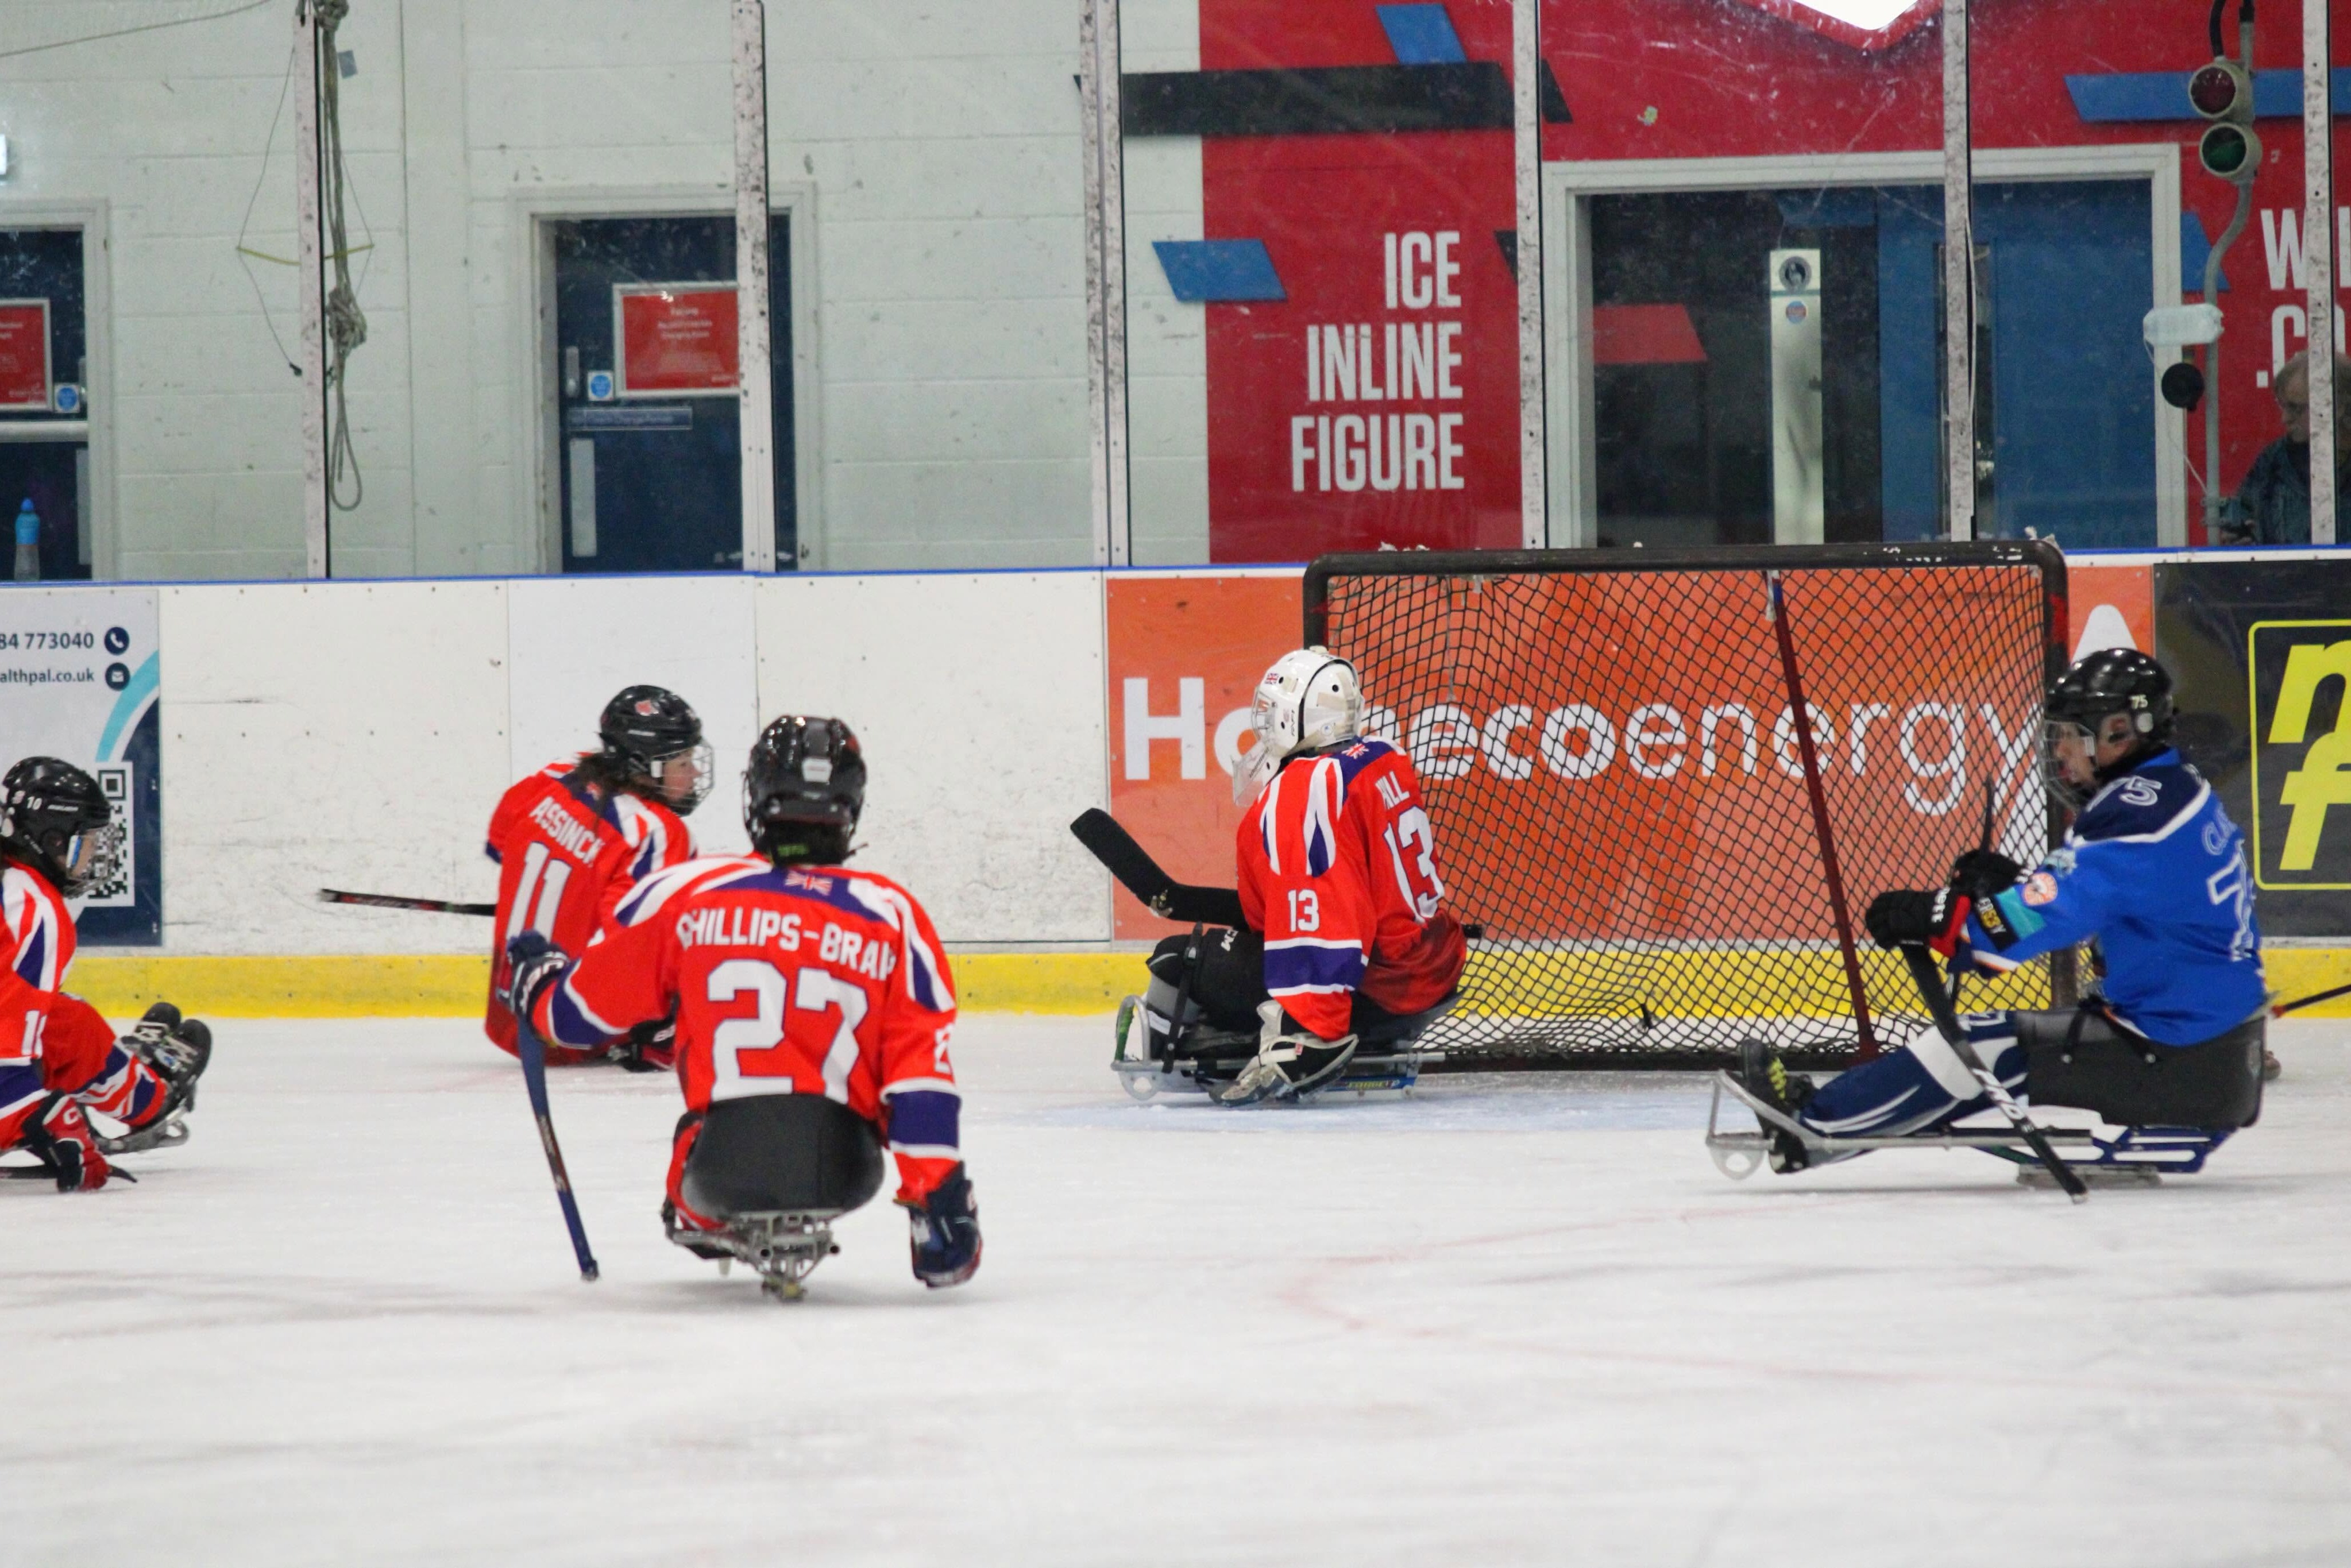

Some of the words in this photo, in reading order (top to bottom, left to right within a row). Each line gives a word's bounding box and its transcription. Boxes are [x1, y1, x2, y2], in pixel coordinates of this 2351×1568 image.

[1384, 231, 1461, 310] ICE
[1307, 322, 1463, 402] INLINE
[1291, 414, 1465, 493] FIGURE
[0, 668, 95, 686] althpal.co.uk
[25, 632, 94, 650] 773040
[2128, 694, 2148, 710] 75
[26, 796, 43, 810] 10
[505, 841, 574, 945] 11
[1383, 805, 1445, 924] 13
[1287, 889, 1320, 933] 13
[707, 959, 869, 1104] 27
